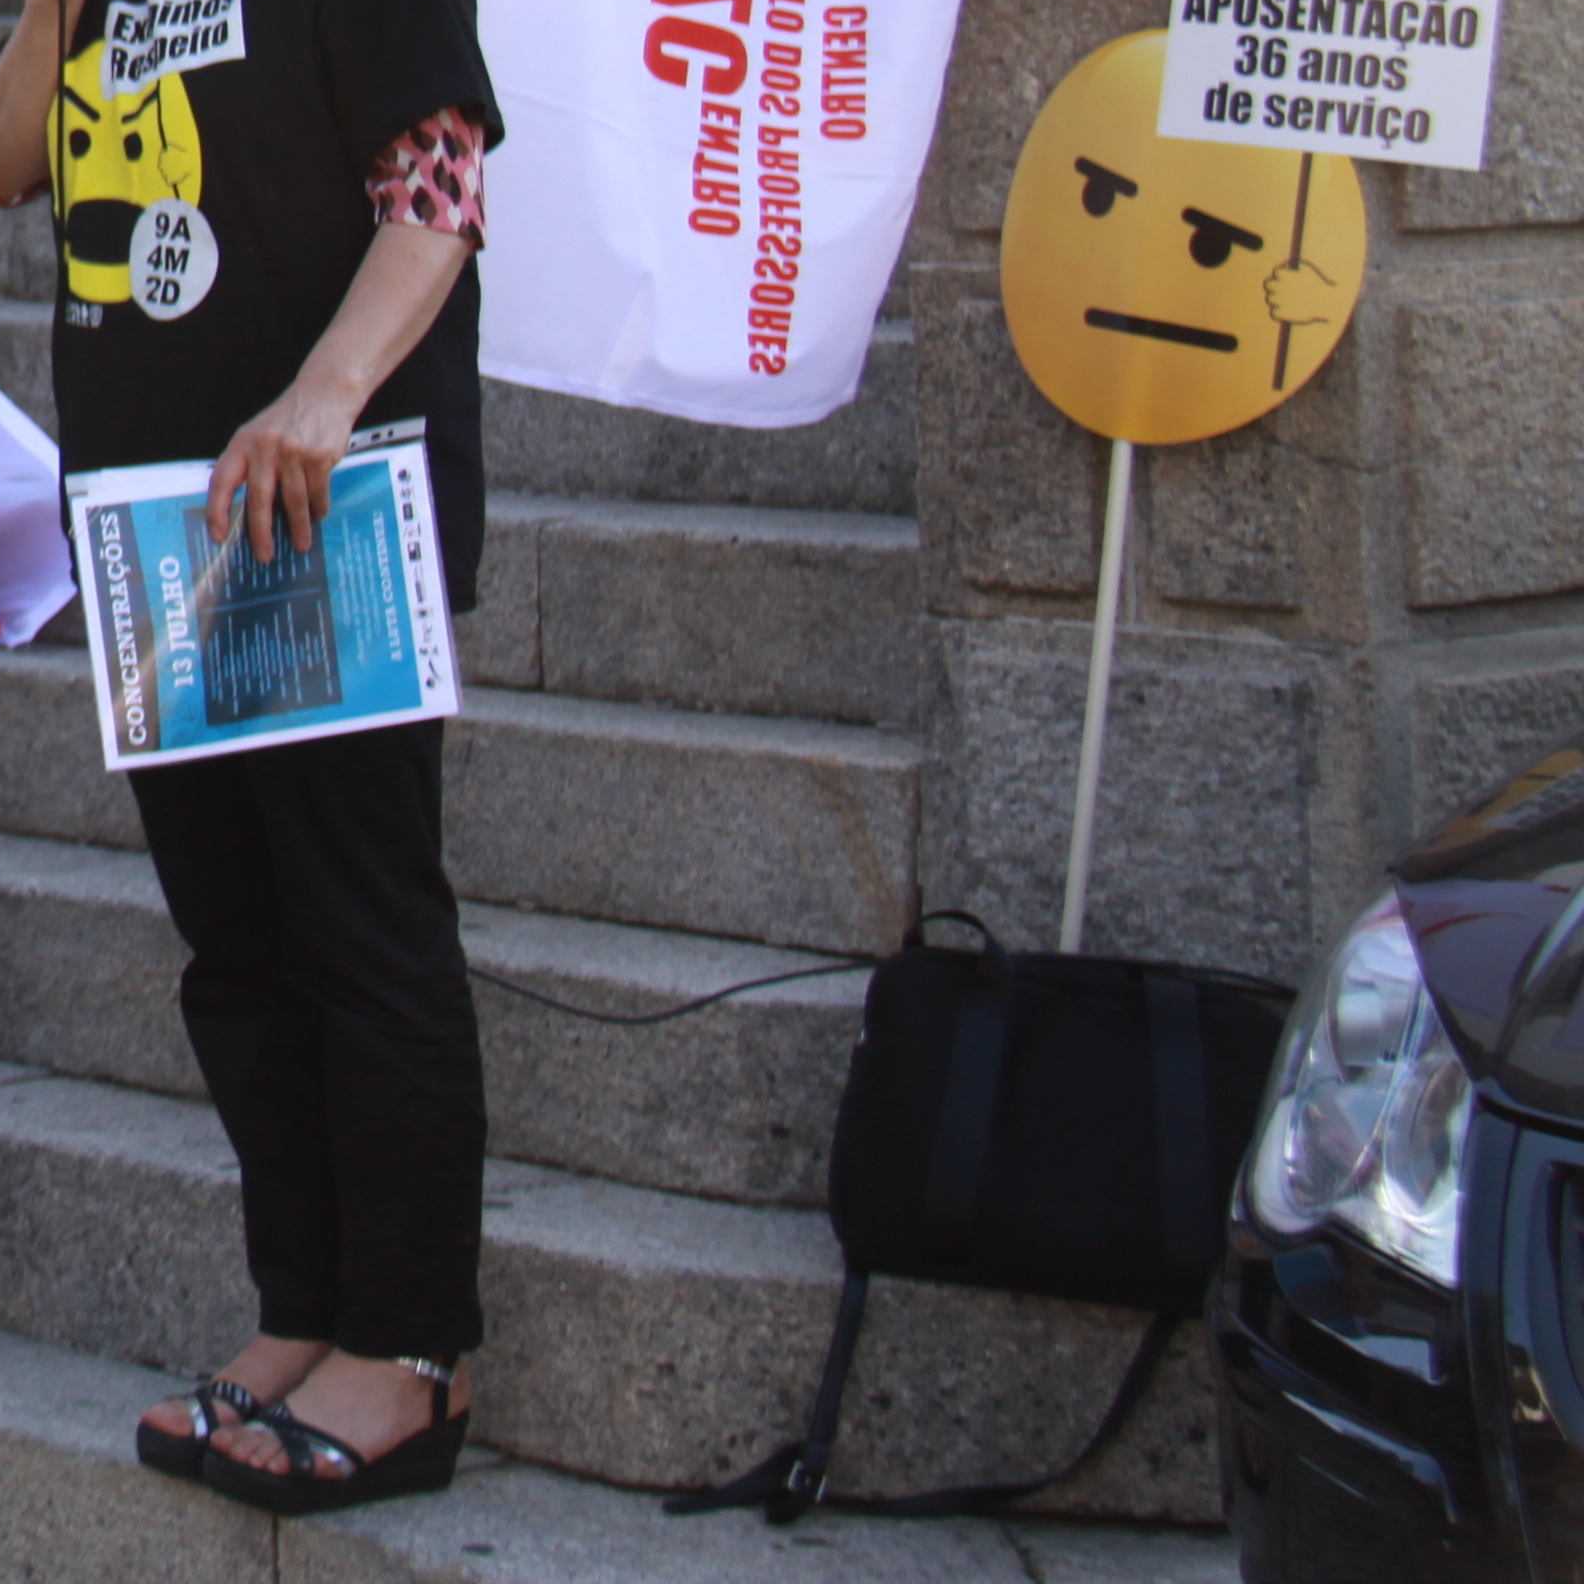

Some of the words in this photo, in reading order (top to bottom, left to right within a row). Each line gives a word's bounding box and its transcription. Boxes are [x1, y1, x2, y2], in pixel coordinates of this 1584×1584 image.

[1233, 34, 1289, 79] 36
[1297, 47, 1408, 91] anos
[1202, 81, 1253, 125] de
[1262, 93, 1432, 150] serviço
[154, 212, 192, 243] 9A
[147, 244, 190, 274] 4M
[145, 277, 181, 306] 2D
[159, 556, 196, 652] JULHO
[100, 510, 148, 746] CONCENTRAÇÕES
[173, 659, 196, 688] 13
